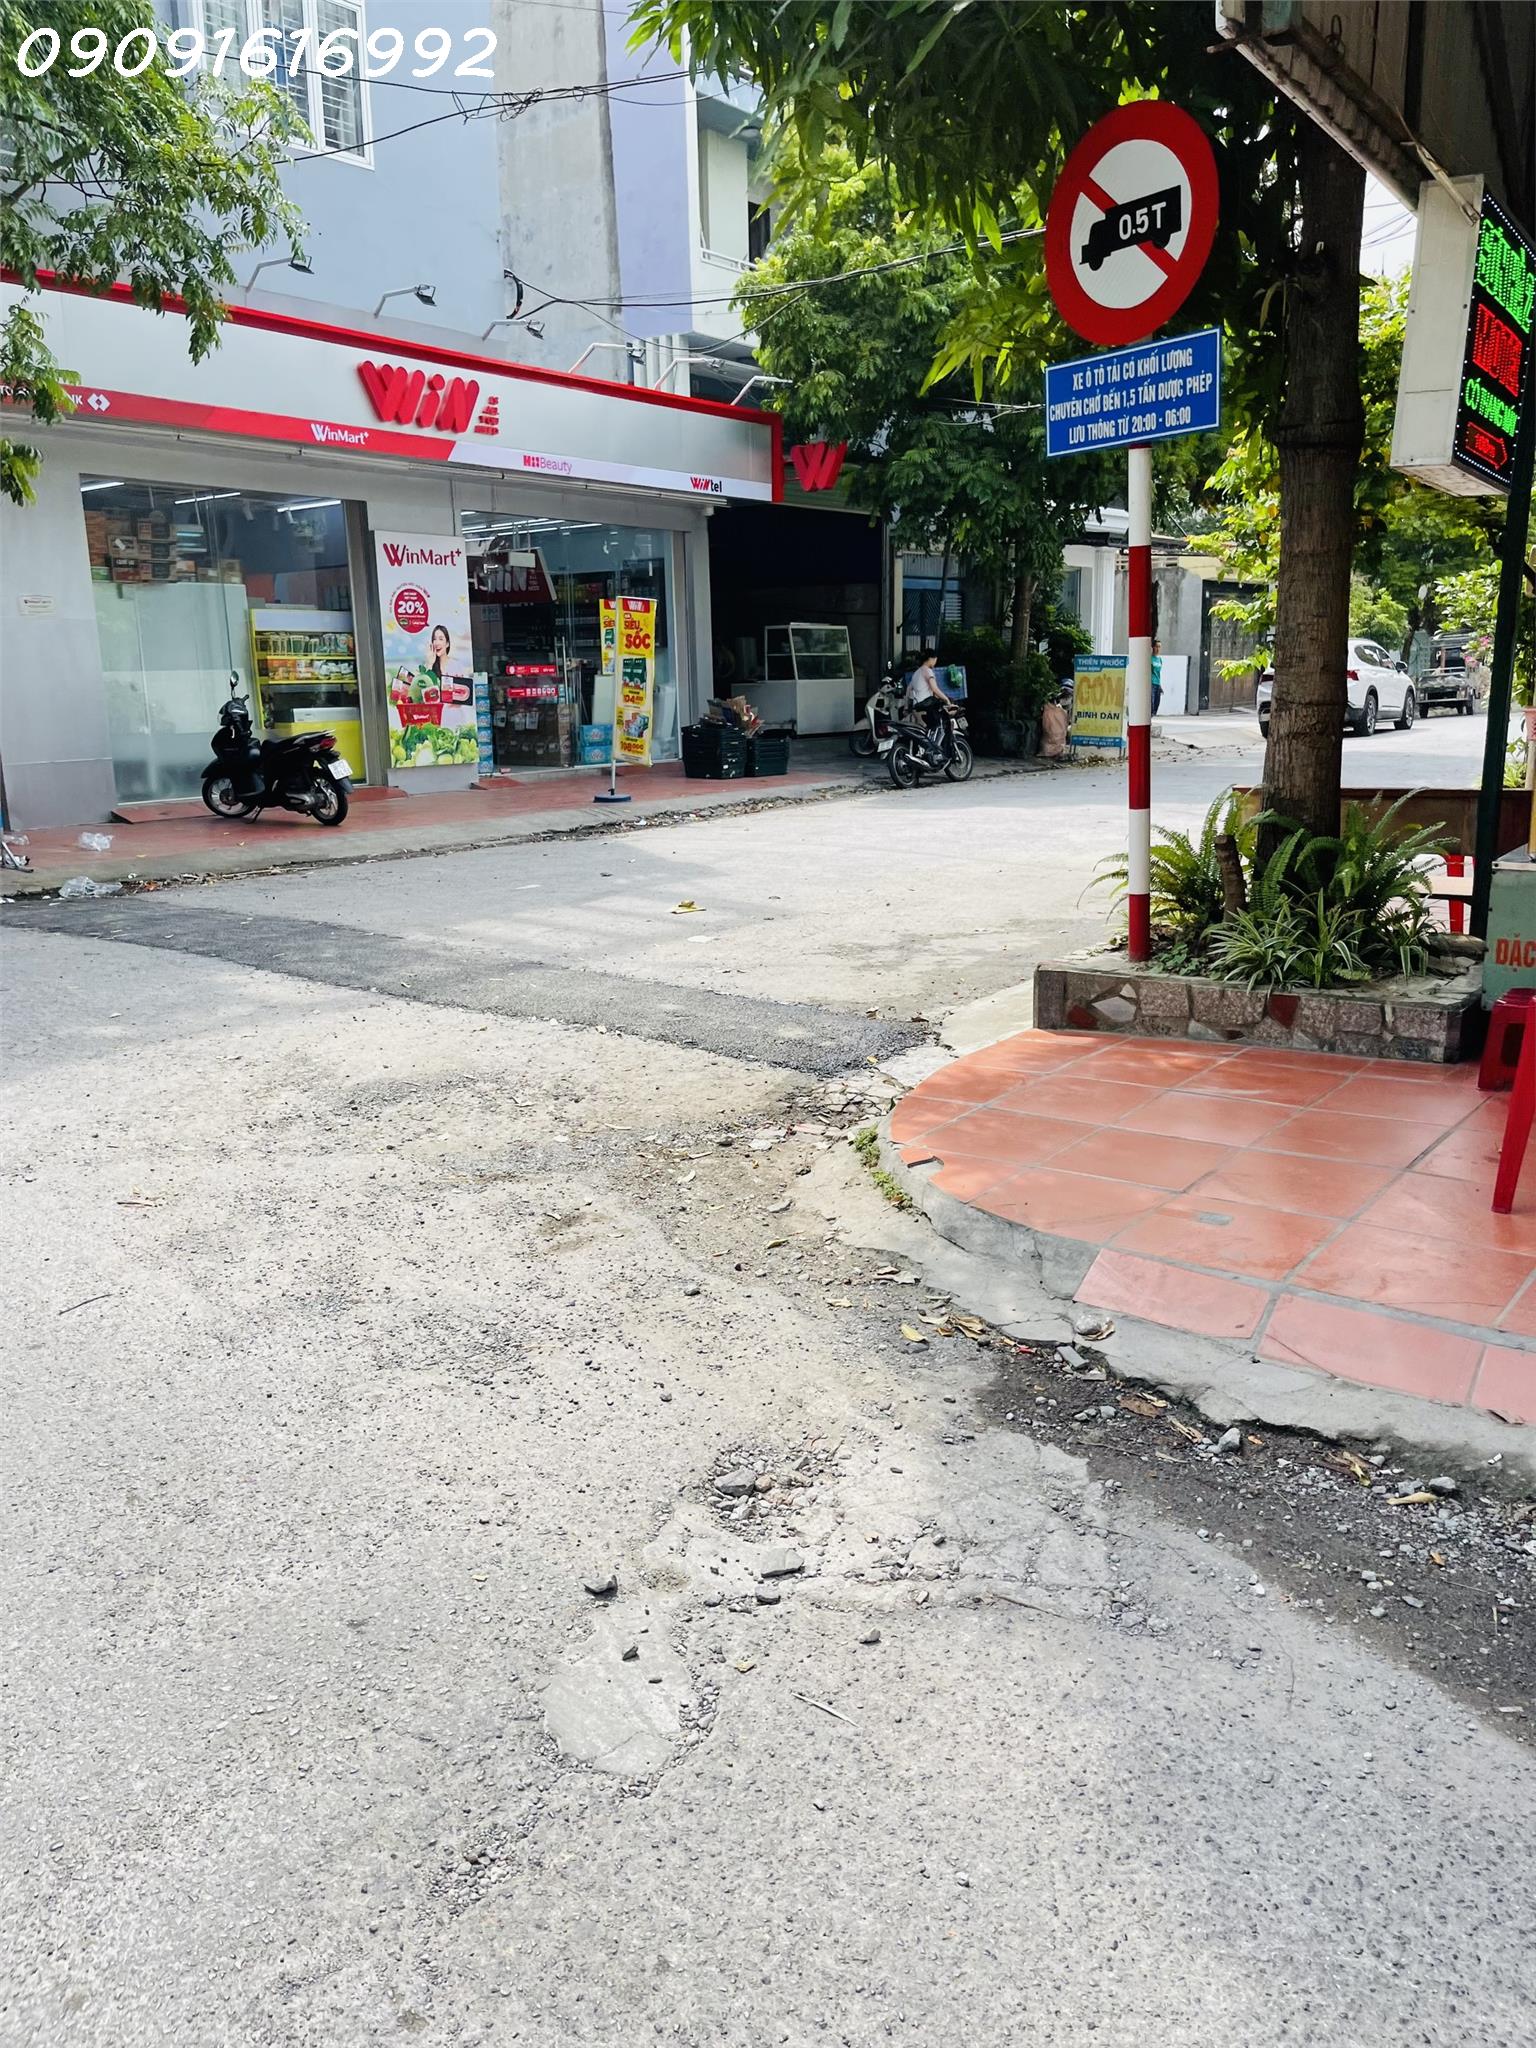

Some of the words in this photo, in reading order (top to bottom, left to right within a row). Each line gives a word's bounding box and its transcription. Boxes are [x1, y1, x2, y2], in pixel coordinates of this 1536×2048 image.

[1072, 373, 1084, 391] XE
[1085, 366, 1092, 388] Ô
[1094, 364, 1105, 387] TÔ
[1106, 358, 1121, 383] TẢI
[1122, 357, 1136, 380] CÓ
[1137, 348, 1160, 377] KHỐI
[1161, 347, 1193, 373] LƯỢNG
[1049, 397, 1083, 422] CHUYÊN
[1083, 388, 1102, 416] CHỞ
[1103, 387, 1121, 412] ĐẾN
[1122, 389, 1136, 409] 1,5
[1138, 378, 1156, 404] TẤN
[1158, 378, 1183, 402] ĐƯỢC
[1186, 369, 1213, 395] PHÉP
[1069, 424, 1085, 445] LƯU
[1087, 418, 1116, 441] THÔNG
[1117, 414, 1131, 436] TỪ
[1131, 413, 1157, 433] 20:00
[1165, 406, 1191, 428] 06:00
[383, 543, 461, 567] WinMart+
[397, 600, 425, 614] 20%
